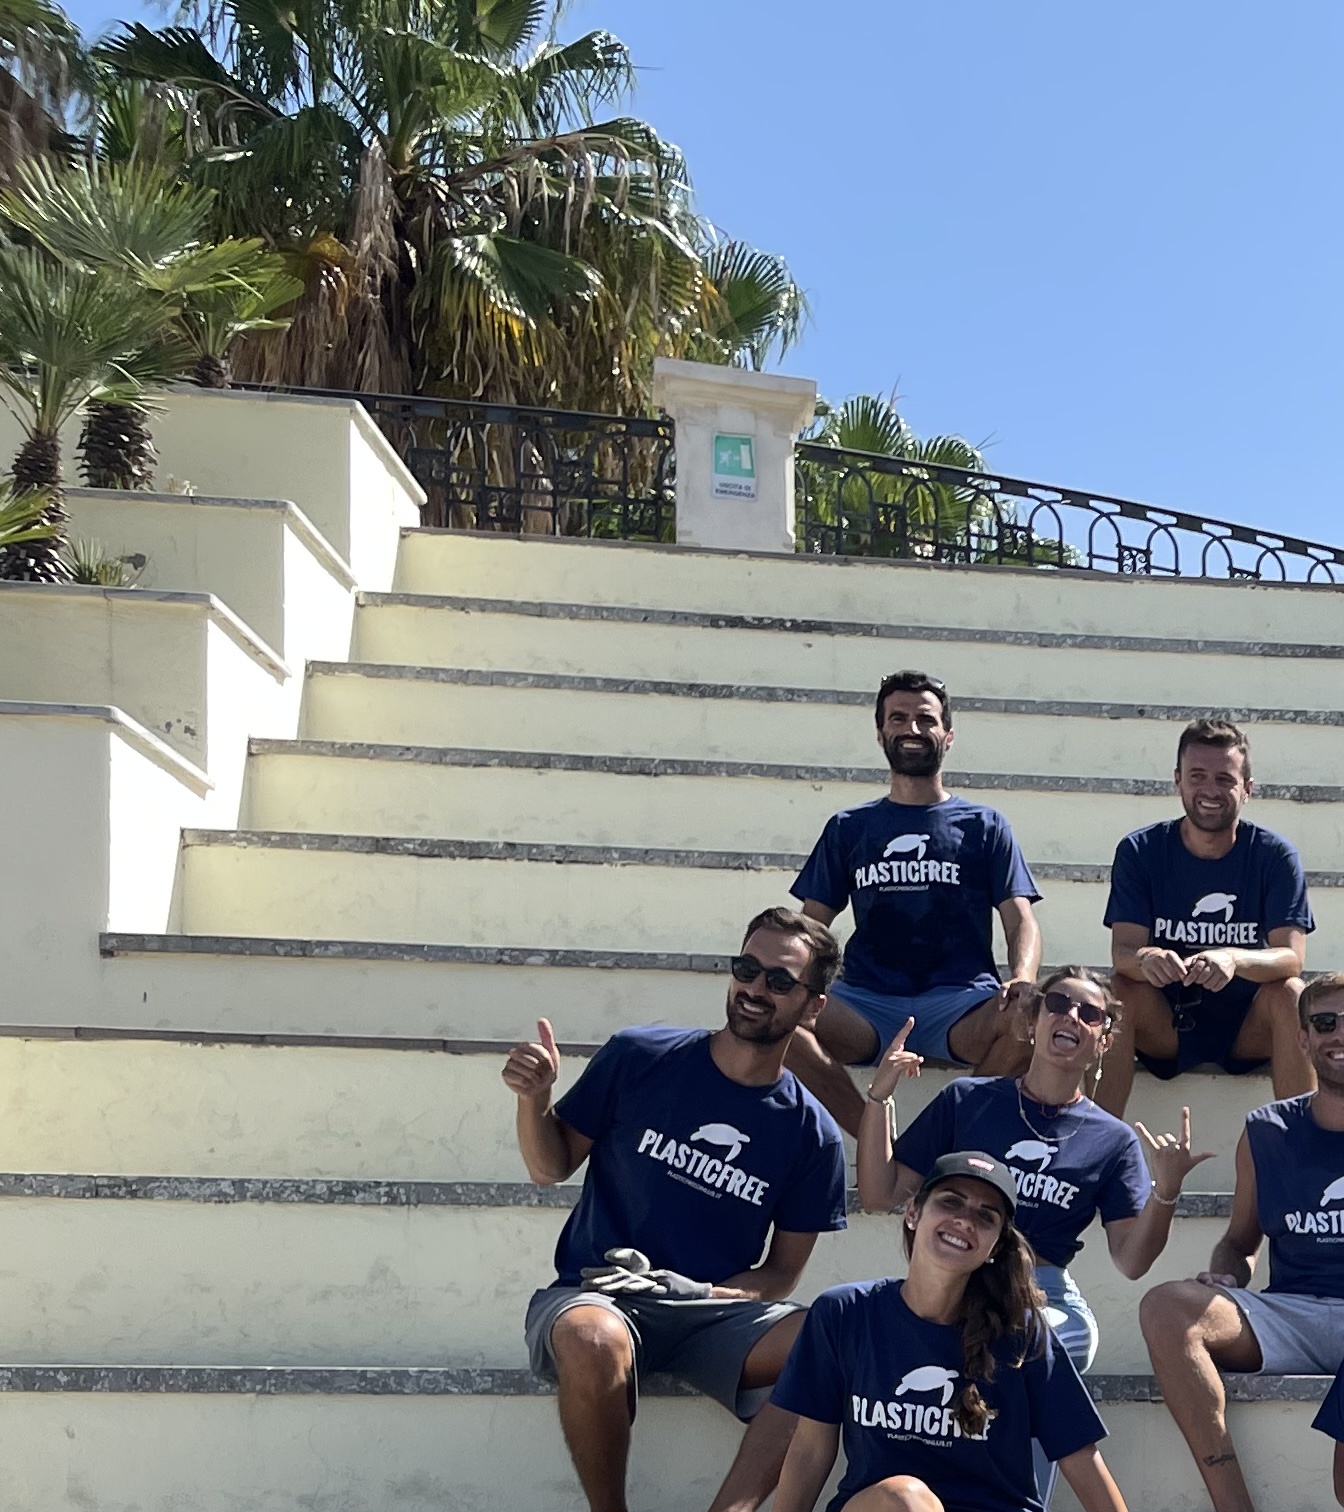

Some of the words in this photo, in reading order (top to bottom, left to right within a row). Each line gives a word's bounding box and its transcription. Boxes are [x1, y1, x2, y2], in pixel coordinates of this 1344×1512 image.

[855, 859, 961, 890] PLASTICFREE
[637, 1128, 770, 1206] PLASTICFREE
[852, 1394, 996, 1441] PLASTICFE
